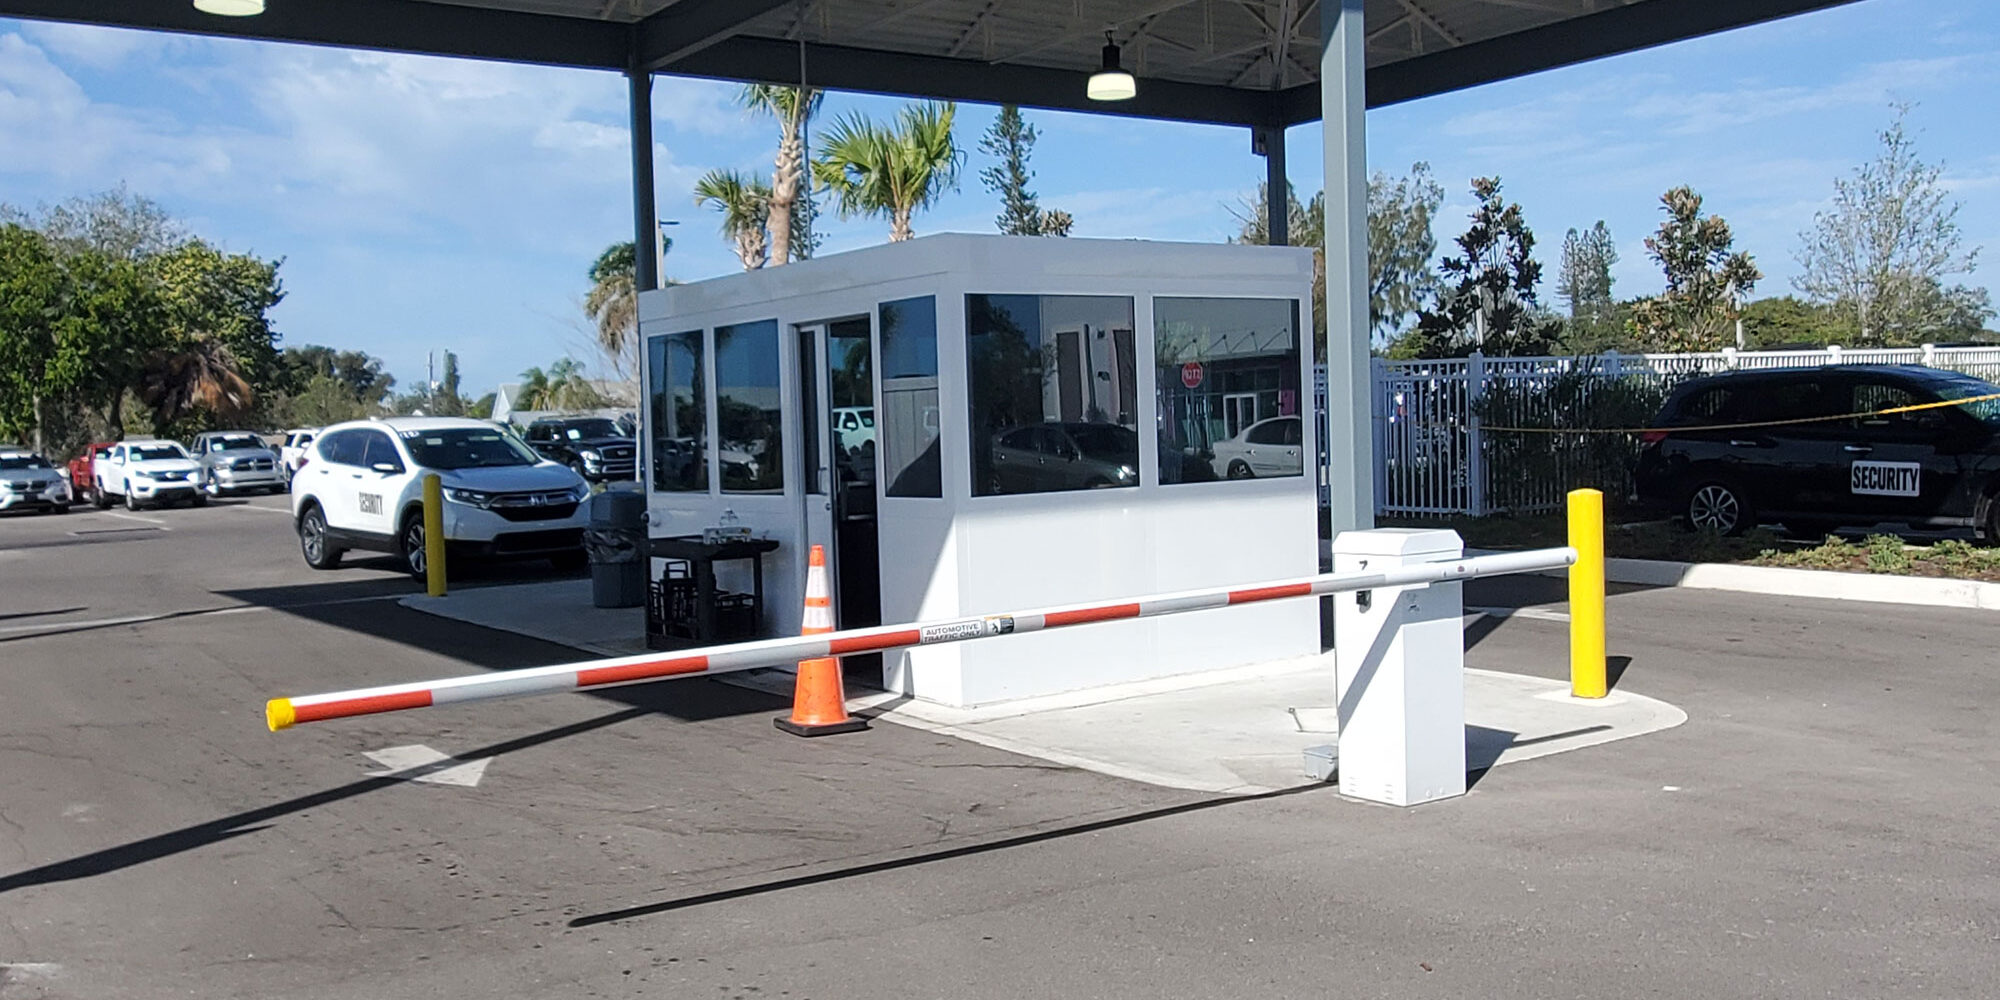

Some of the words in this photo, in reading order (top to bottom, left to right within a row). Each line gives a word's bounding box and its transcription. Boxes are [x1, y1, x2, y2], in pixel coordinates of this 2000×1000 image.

[1853, 465, 1918, 491] SECURITY
[359, 491, 383, 515] SECURITY
[924, 632, 958, 642] TRAFFIC
[960, 630, 980, 638] ONLY
[926, 623, 978, 635] AUTOMOTIVE
